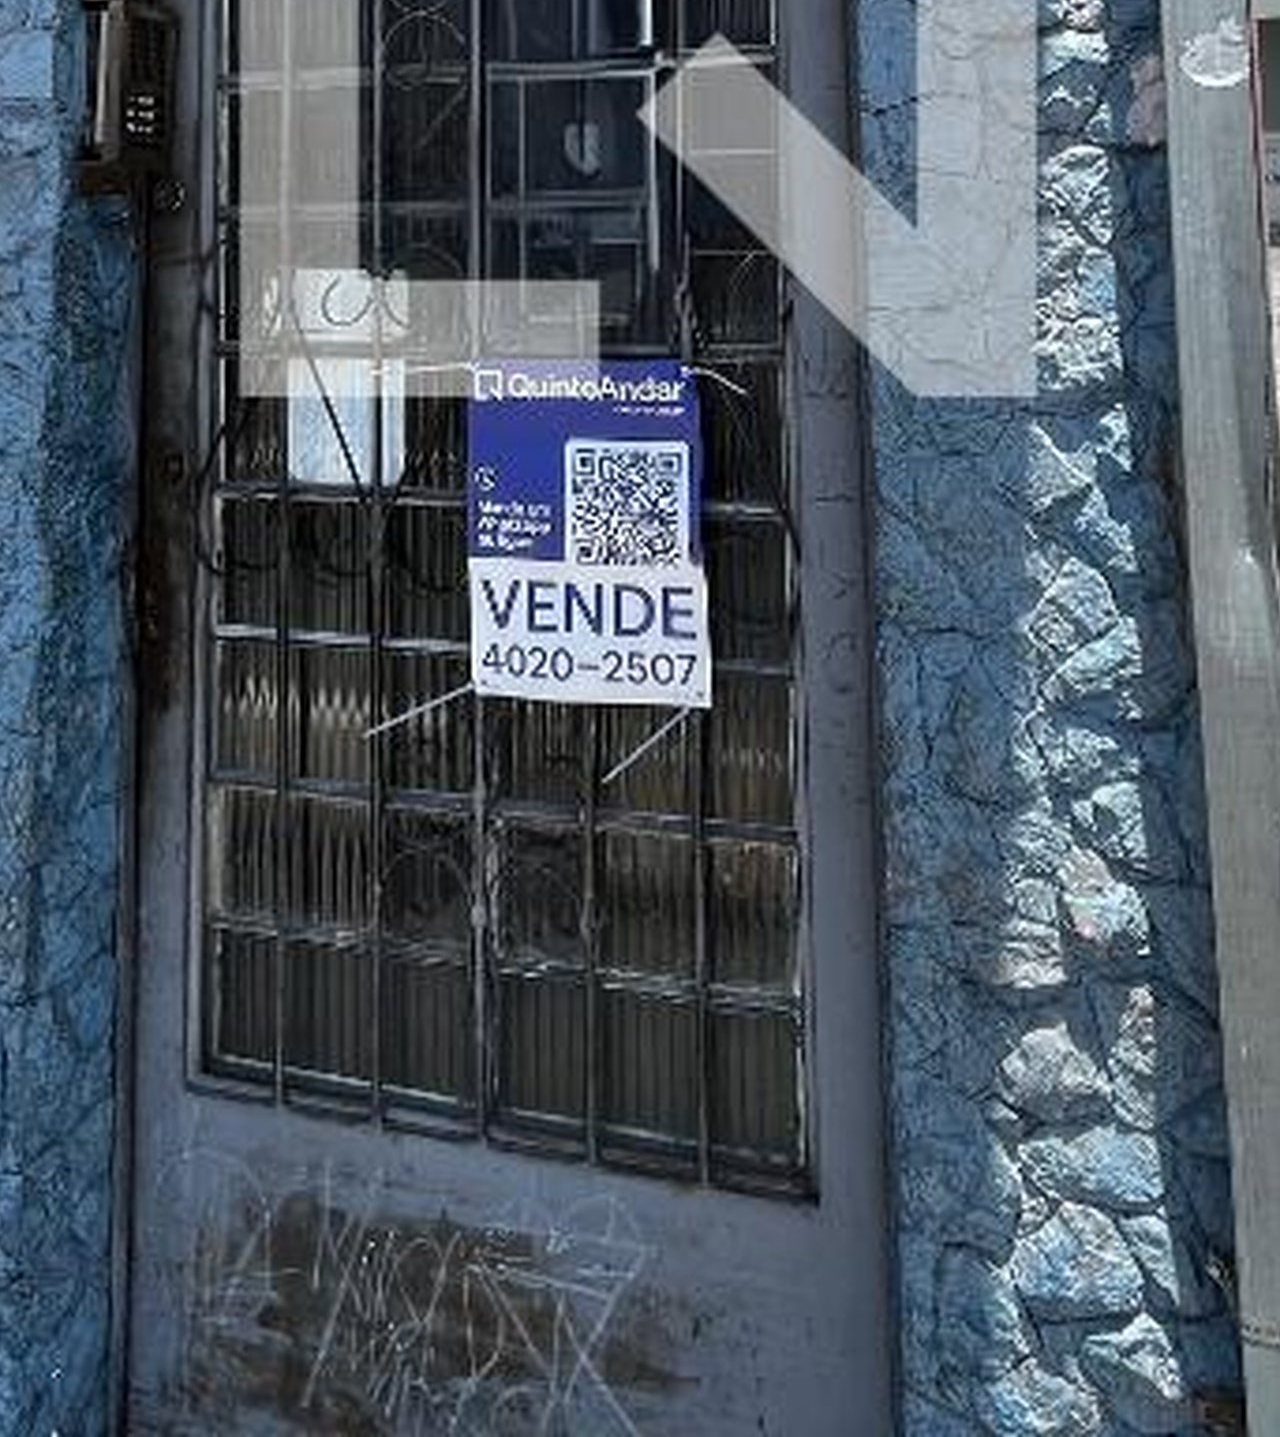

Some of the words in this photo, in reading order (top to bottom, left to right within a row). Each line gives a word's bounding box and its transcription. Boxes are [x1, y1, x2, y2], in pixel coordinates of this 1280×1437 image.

[508, 374, 687, 403] QuintoAndar
[482, 579, 698, 640] VENDE
[482, 643, 698, 686] 4020-2507
